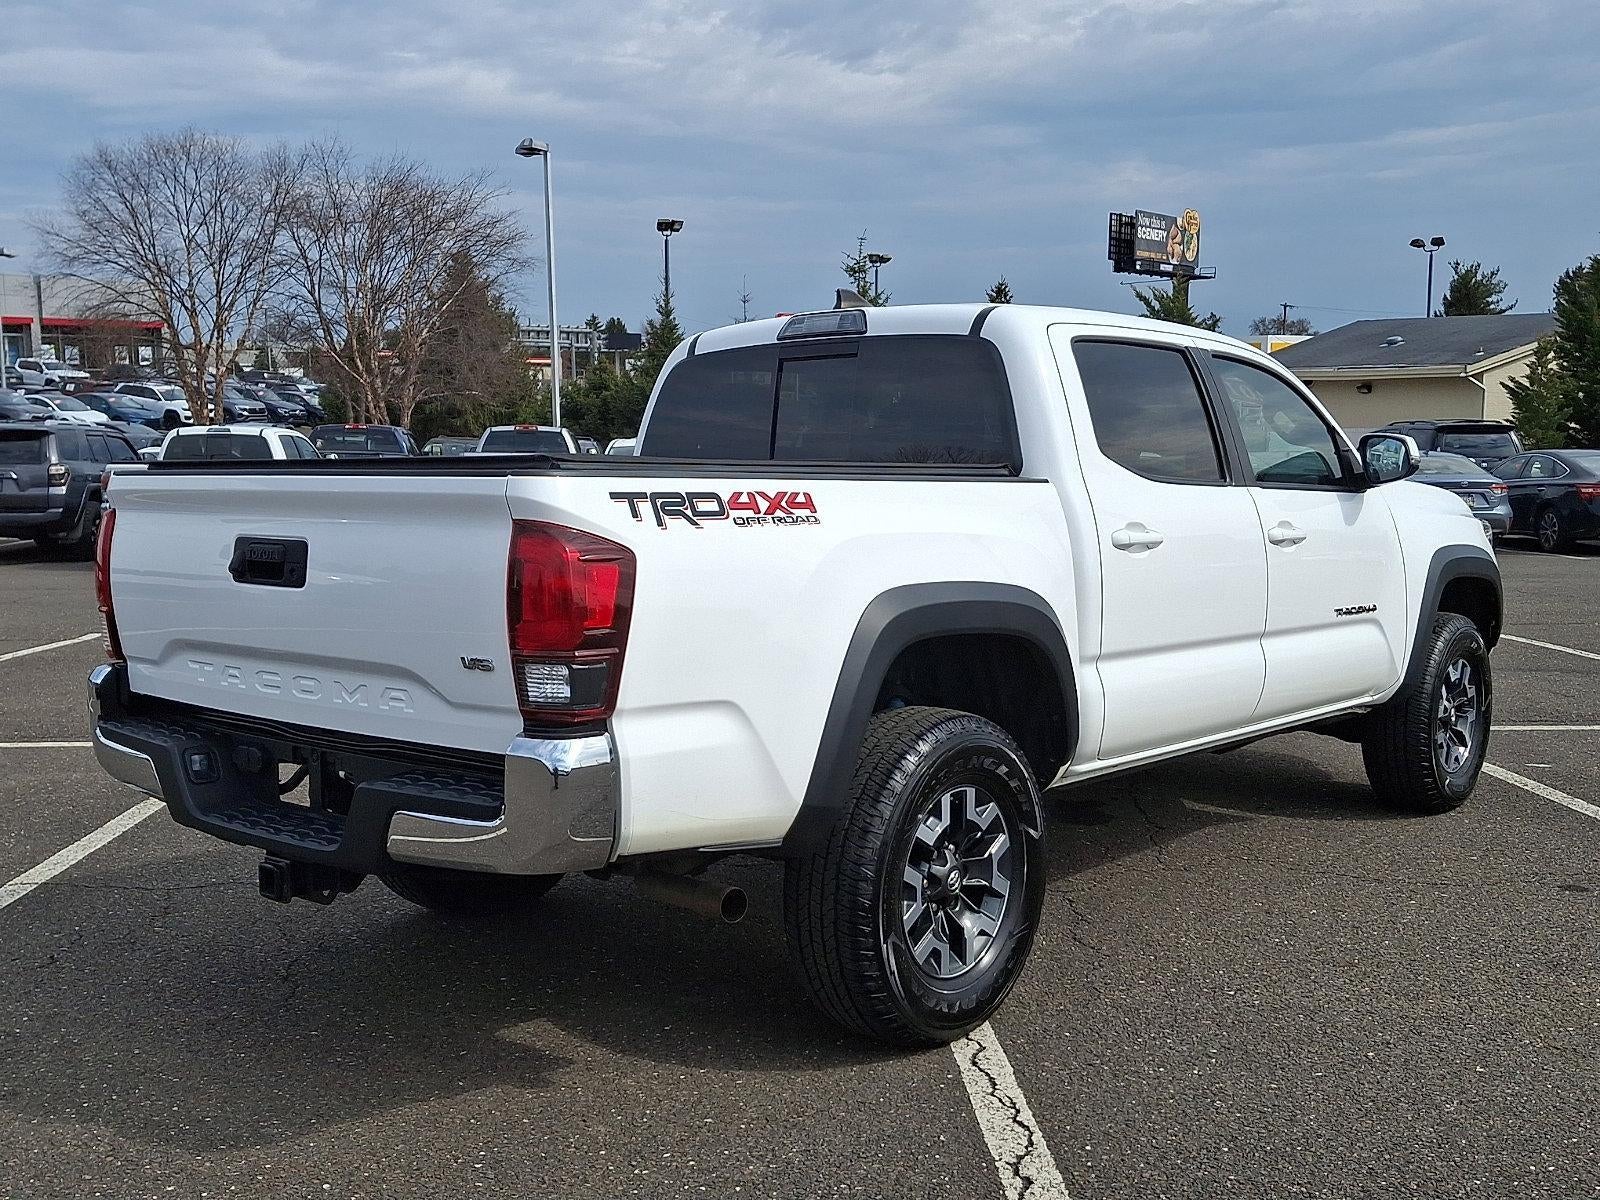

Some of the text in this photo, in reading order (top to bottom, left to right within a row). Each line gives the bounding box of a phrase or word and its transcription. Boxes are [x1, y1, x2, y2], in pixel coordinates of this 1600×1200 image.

[1138, 213, 1166, 229] Now this is
[1137, 226, 1168, 242] SCENERY
[609, 491, 818, 529] TRD 4X4
[733, 515, 820, 527] OFF ROAD
[247, 548, 279, 560] TOYOTA
[1333, 604, 1377, 617] TACOMA
[459, 655, 496, 672] V6
[187, 658, 415, 713] TACOMA
